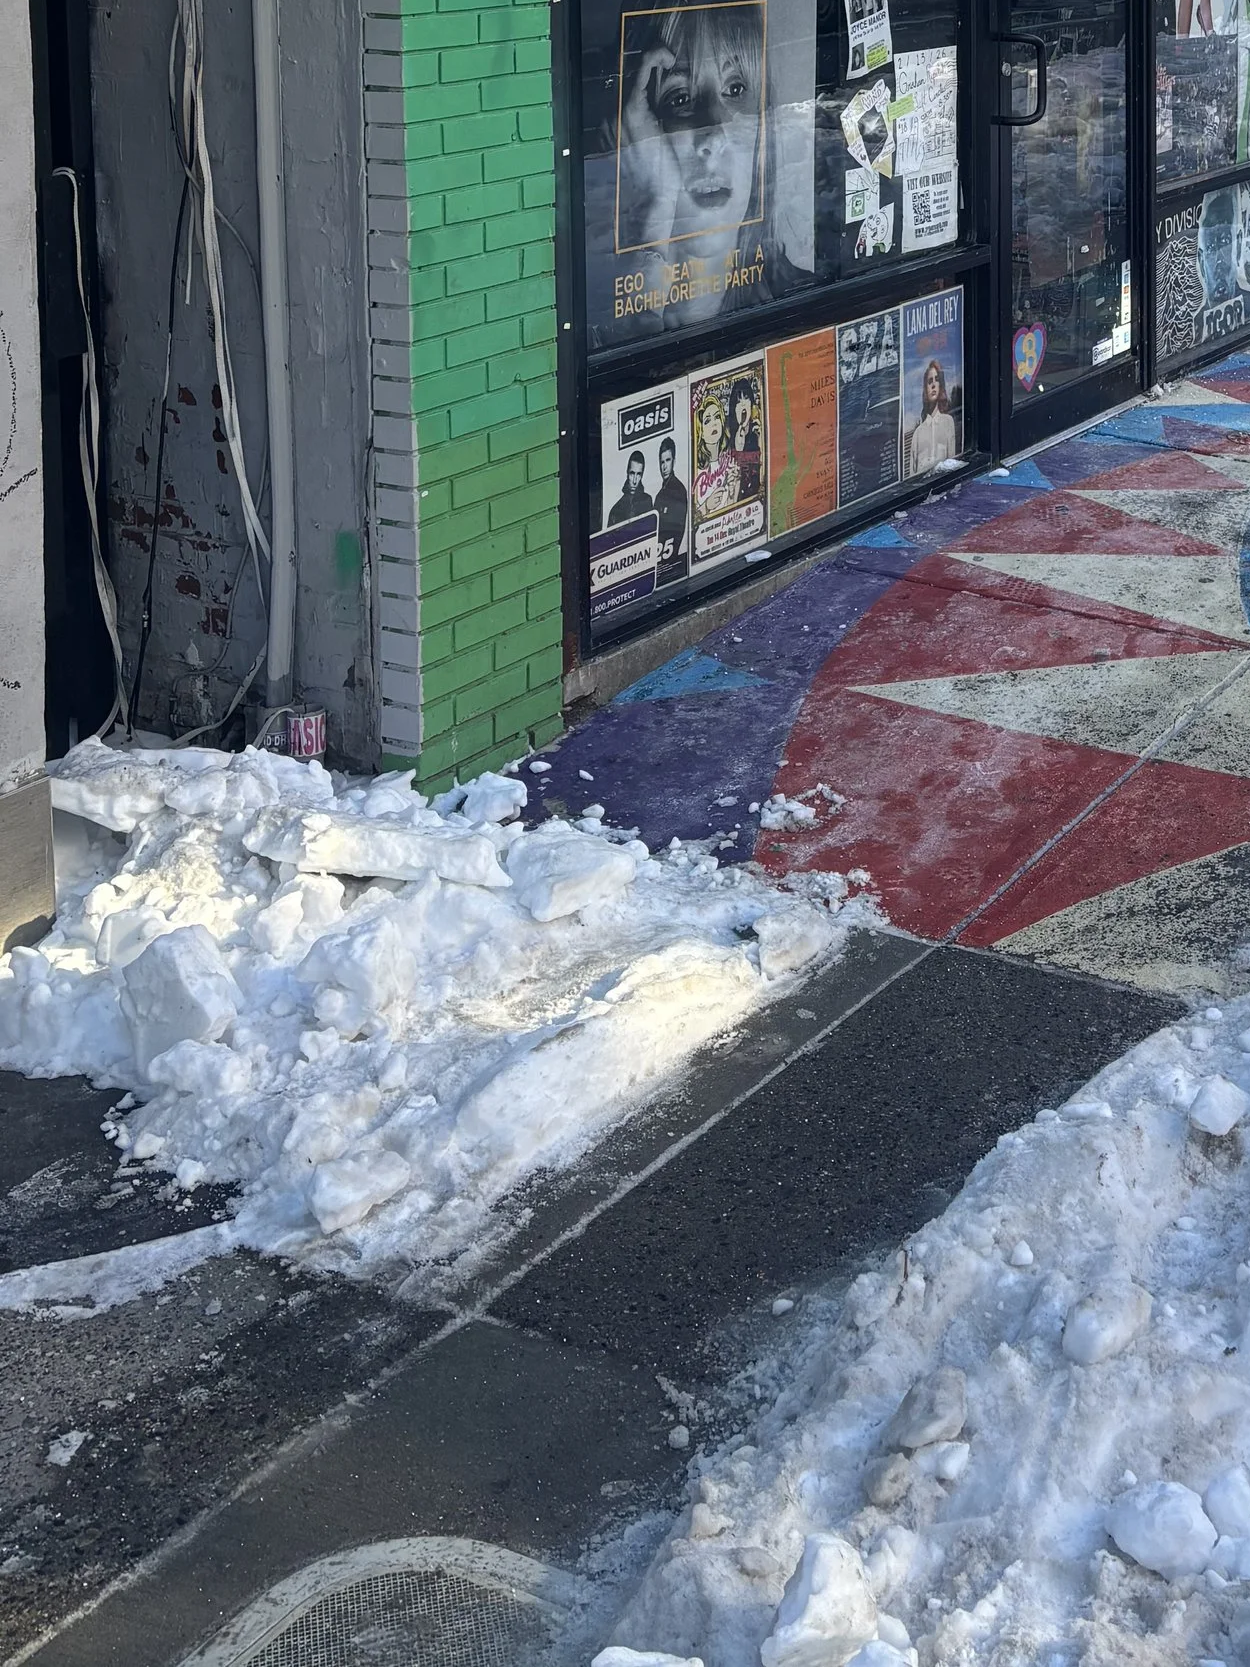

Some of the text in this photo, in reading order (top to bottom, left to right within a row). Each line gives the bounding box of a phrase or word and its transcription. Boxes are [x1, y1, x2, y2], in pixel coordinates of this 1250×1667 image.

[615, 272, 644, 296] EGO
[725, 249, 740, 270] AT
[755, 244, 764, 261] A
[615, 263, 765, 319] BACHELORETTE PARTY
[907, 295, 959, 337] LANA DEL REY
[839, 314, 898, 383] SZA
[810, 375, 836, 392] MILES
[810, 391, 836, 409] DAVIS
[623, 404, 669, 437] oasis
[597, 545, 652, 579] GUARDIAN
